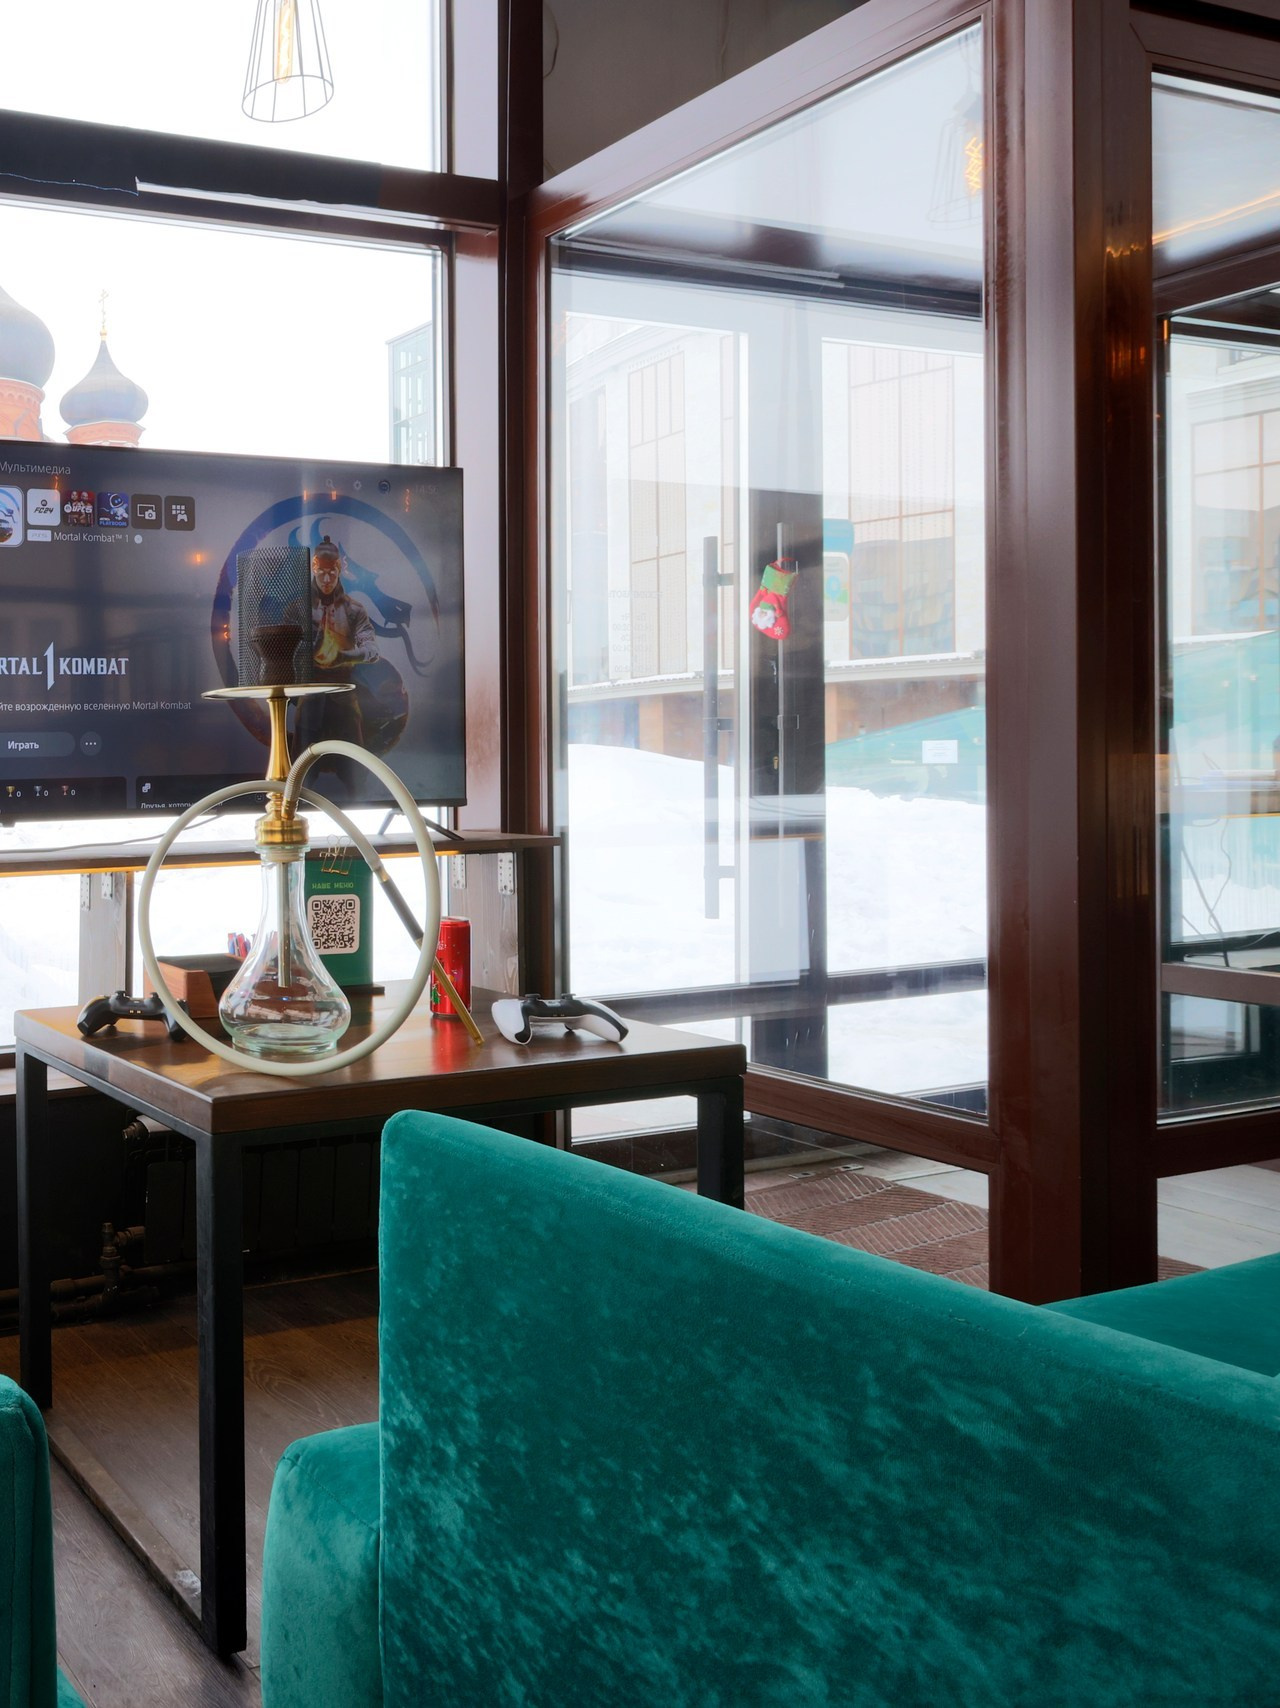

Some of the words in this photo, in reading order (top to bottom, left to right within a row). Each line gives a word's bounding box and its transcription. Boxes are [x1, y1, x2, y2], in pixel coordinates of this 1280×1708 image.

[53, 532, 81, 541] Mortal
[125, 535, 129, 543] 1
[59, 657, 129, 676] KOMBAT
[15, 702, 82, 712] возрожденную
[83, 702, 131, 712] вселенную
[132, 701, 159, 710] Mortal
[160, 701, 192, 710] Kombat
[7, 741, 40, 751] Играть
[16, 790, 22, 798] 0
